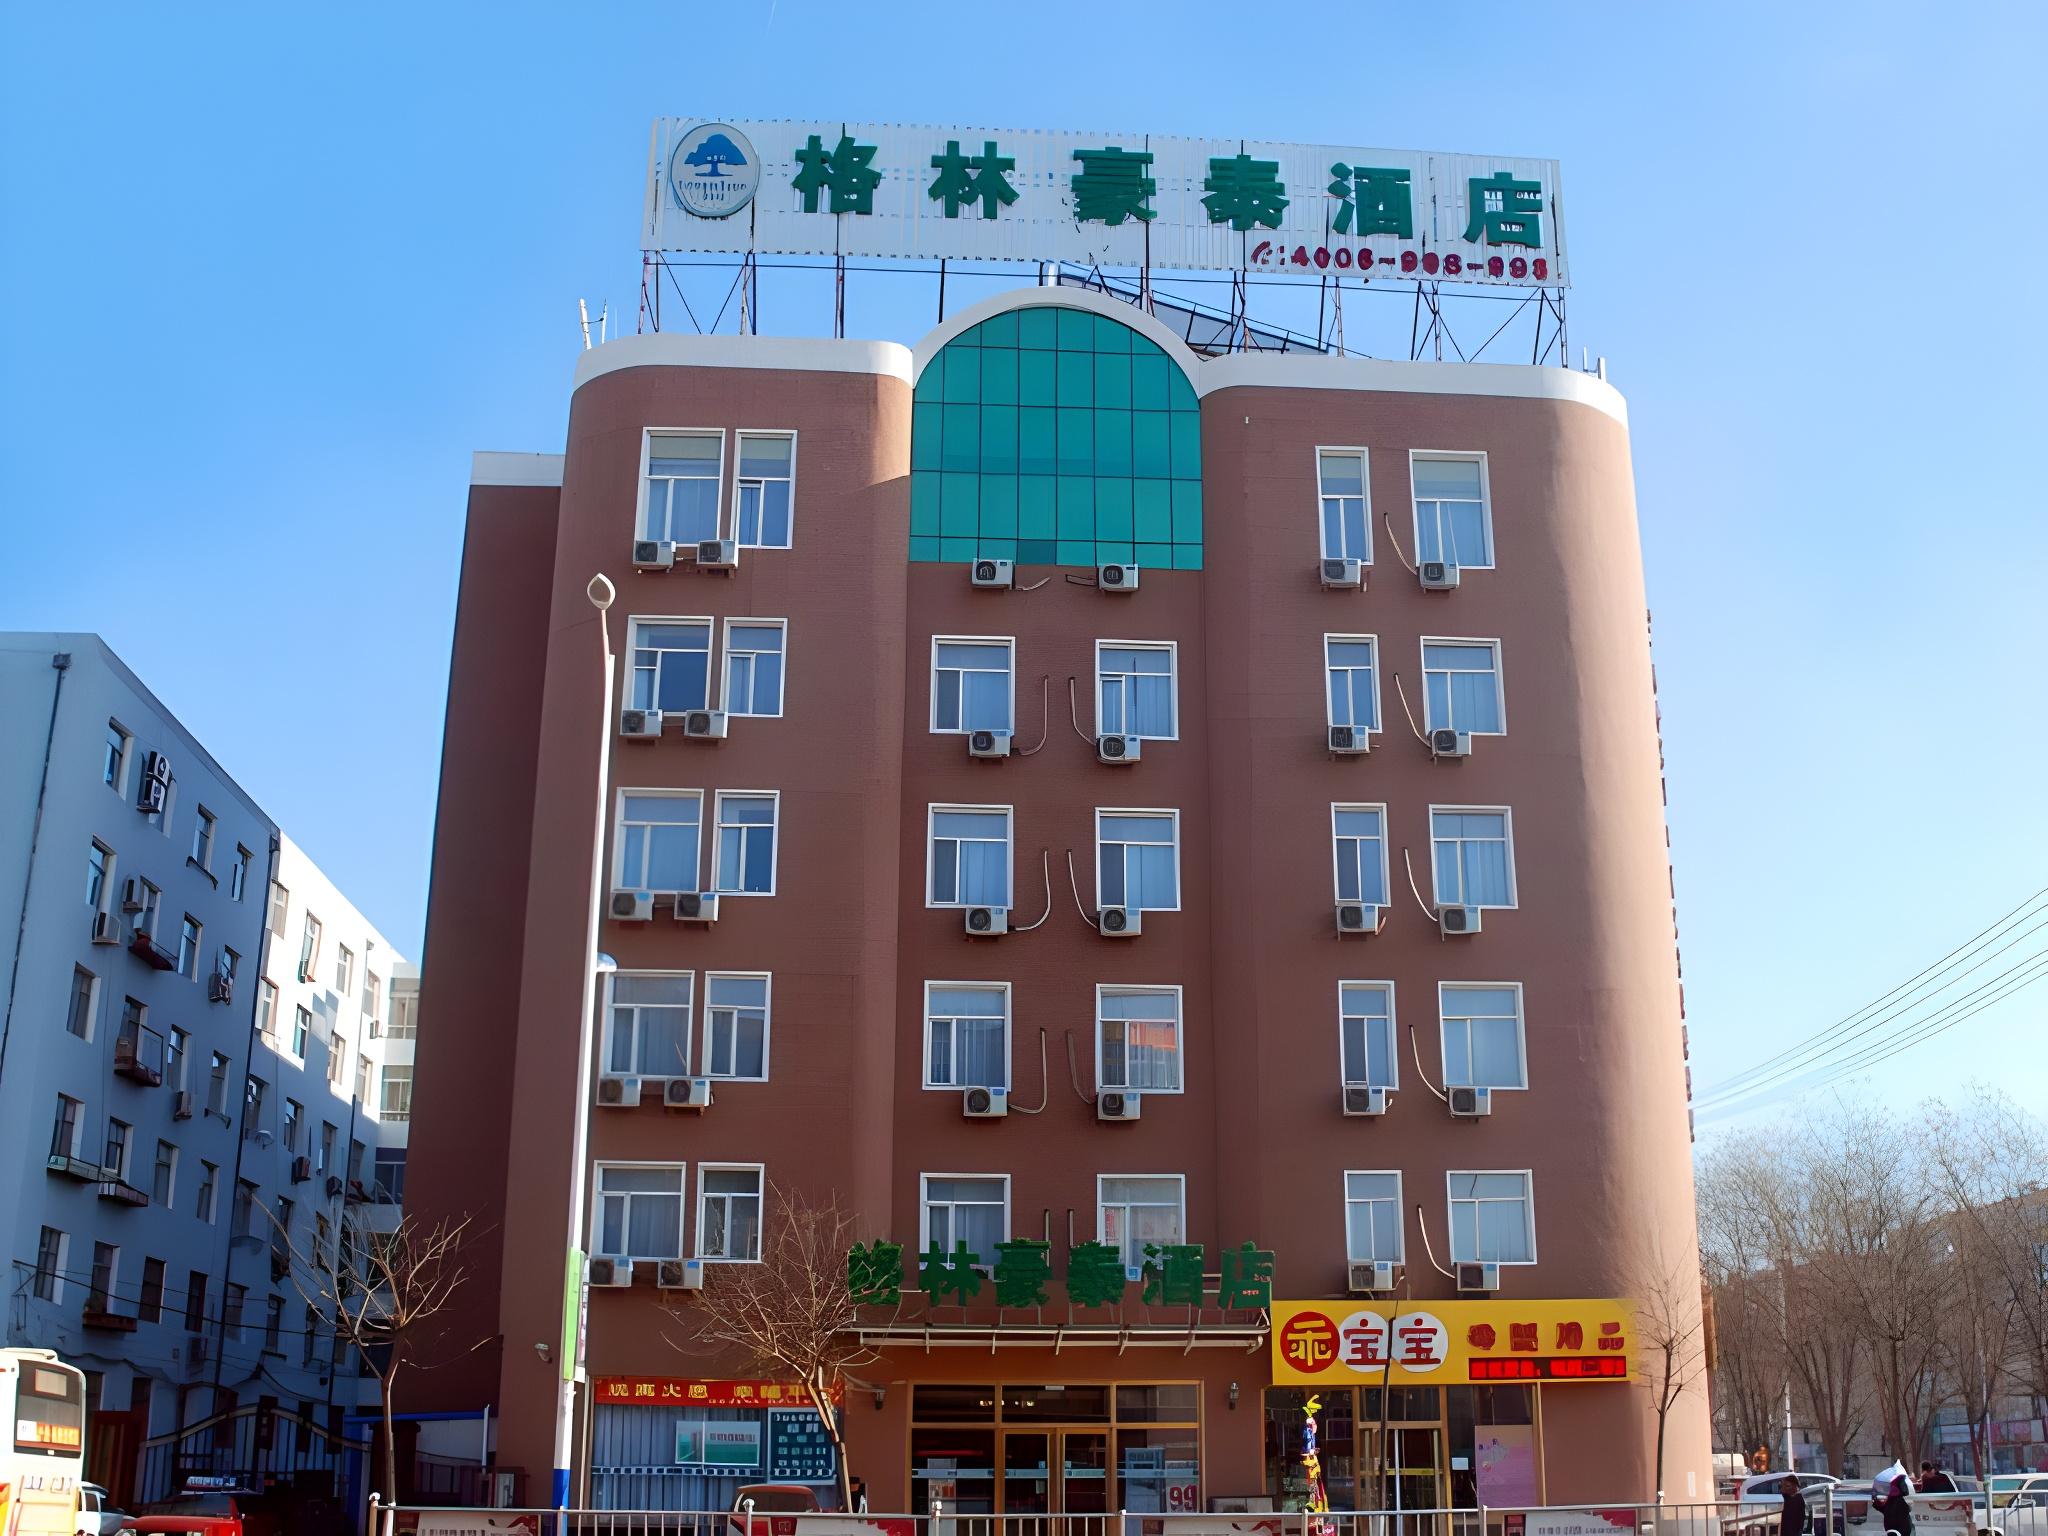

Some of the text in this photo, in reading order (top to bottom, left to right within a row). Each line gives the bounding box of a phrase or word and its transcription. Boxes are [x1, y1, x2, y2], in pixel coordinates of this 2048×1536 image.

[791, 135, 1542, 248] 格林豪泰酒店
[1287, 1318, 1442, 1366] 乖宝宝
